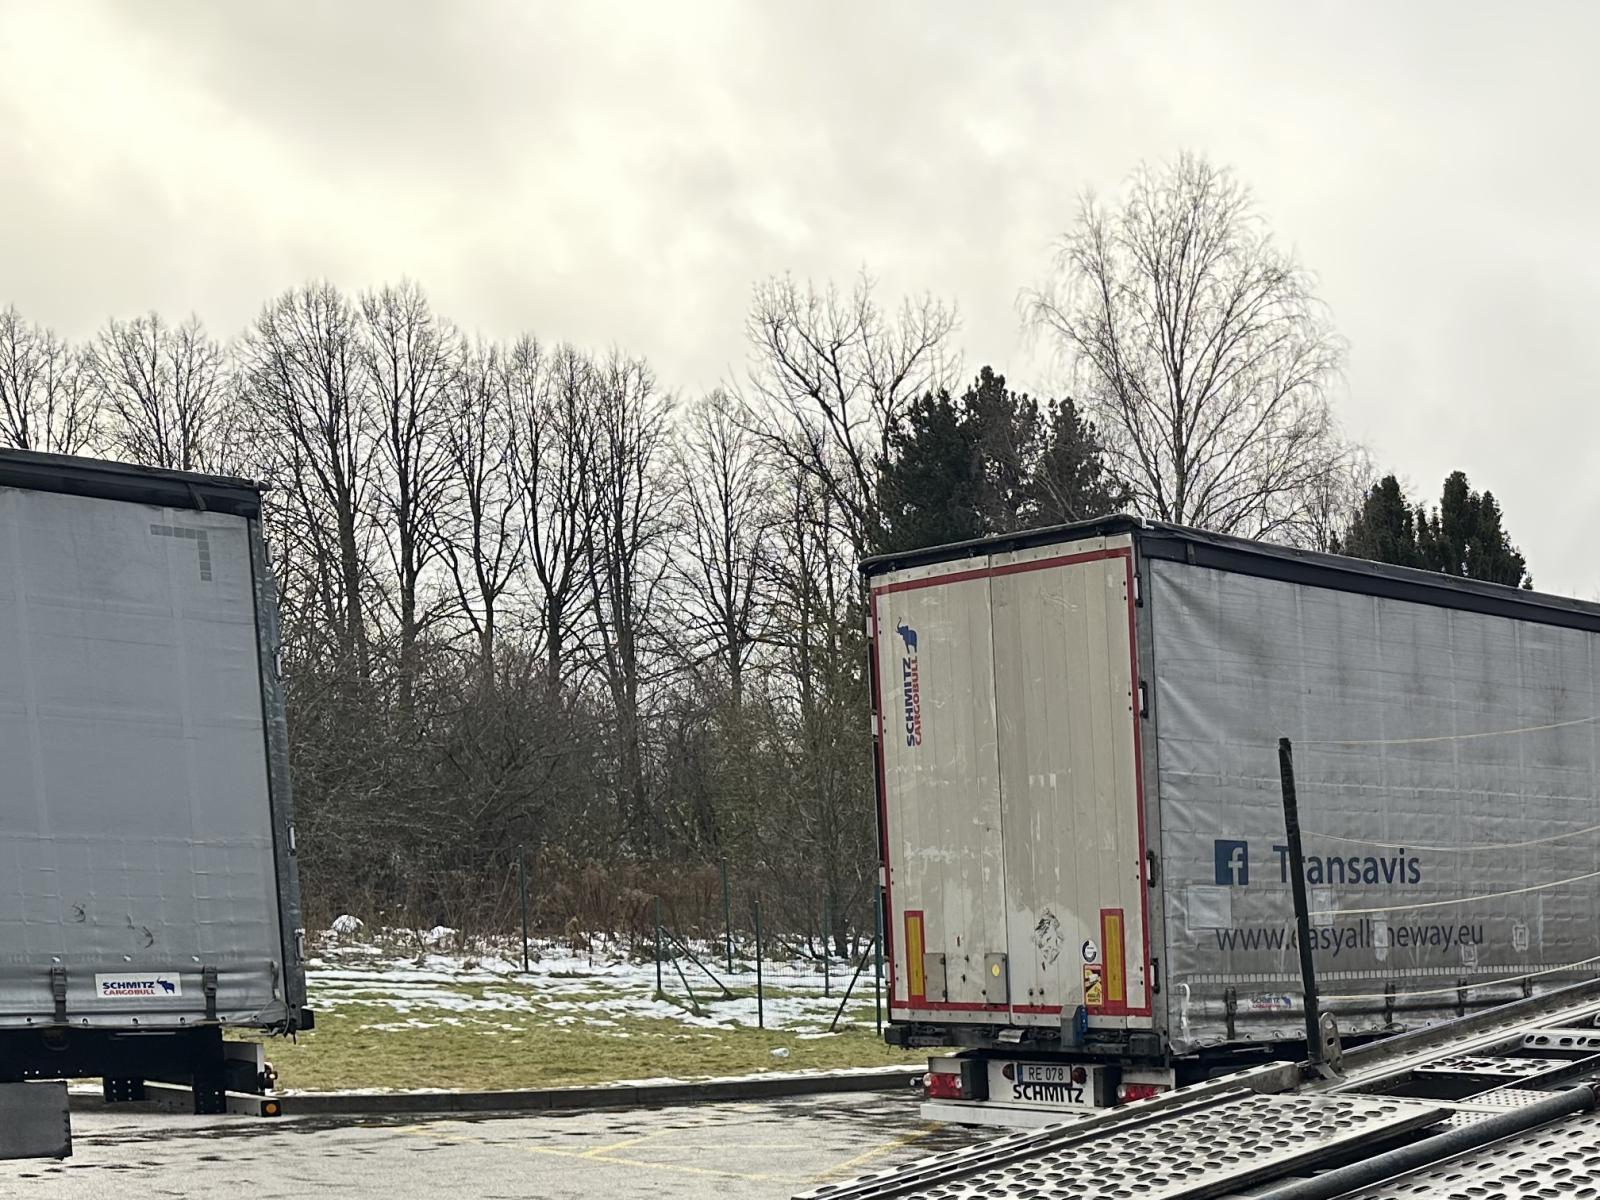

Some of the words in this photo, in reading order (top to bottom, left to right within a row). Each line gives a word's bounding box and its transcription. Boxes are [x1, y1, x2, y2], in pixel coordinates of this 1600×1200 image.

[903, 657, 915, 746] SCHMITZ
[912, 656, 921, 746] CARGOBULL
[1273, 845, 1421, 884] Tansavis
[103, 981, 155, 989] SCHMITZ
[103, 988, 156, 996] CARGOBULL
[1028, 1067, 1042, 1081] RE
[1045, 1067, 1064, 1081] 078
[1013, 1084, 1084, 1104] SCHMITZ
